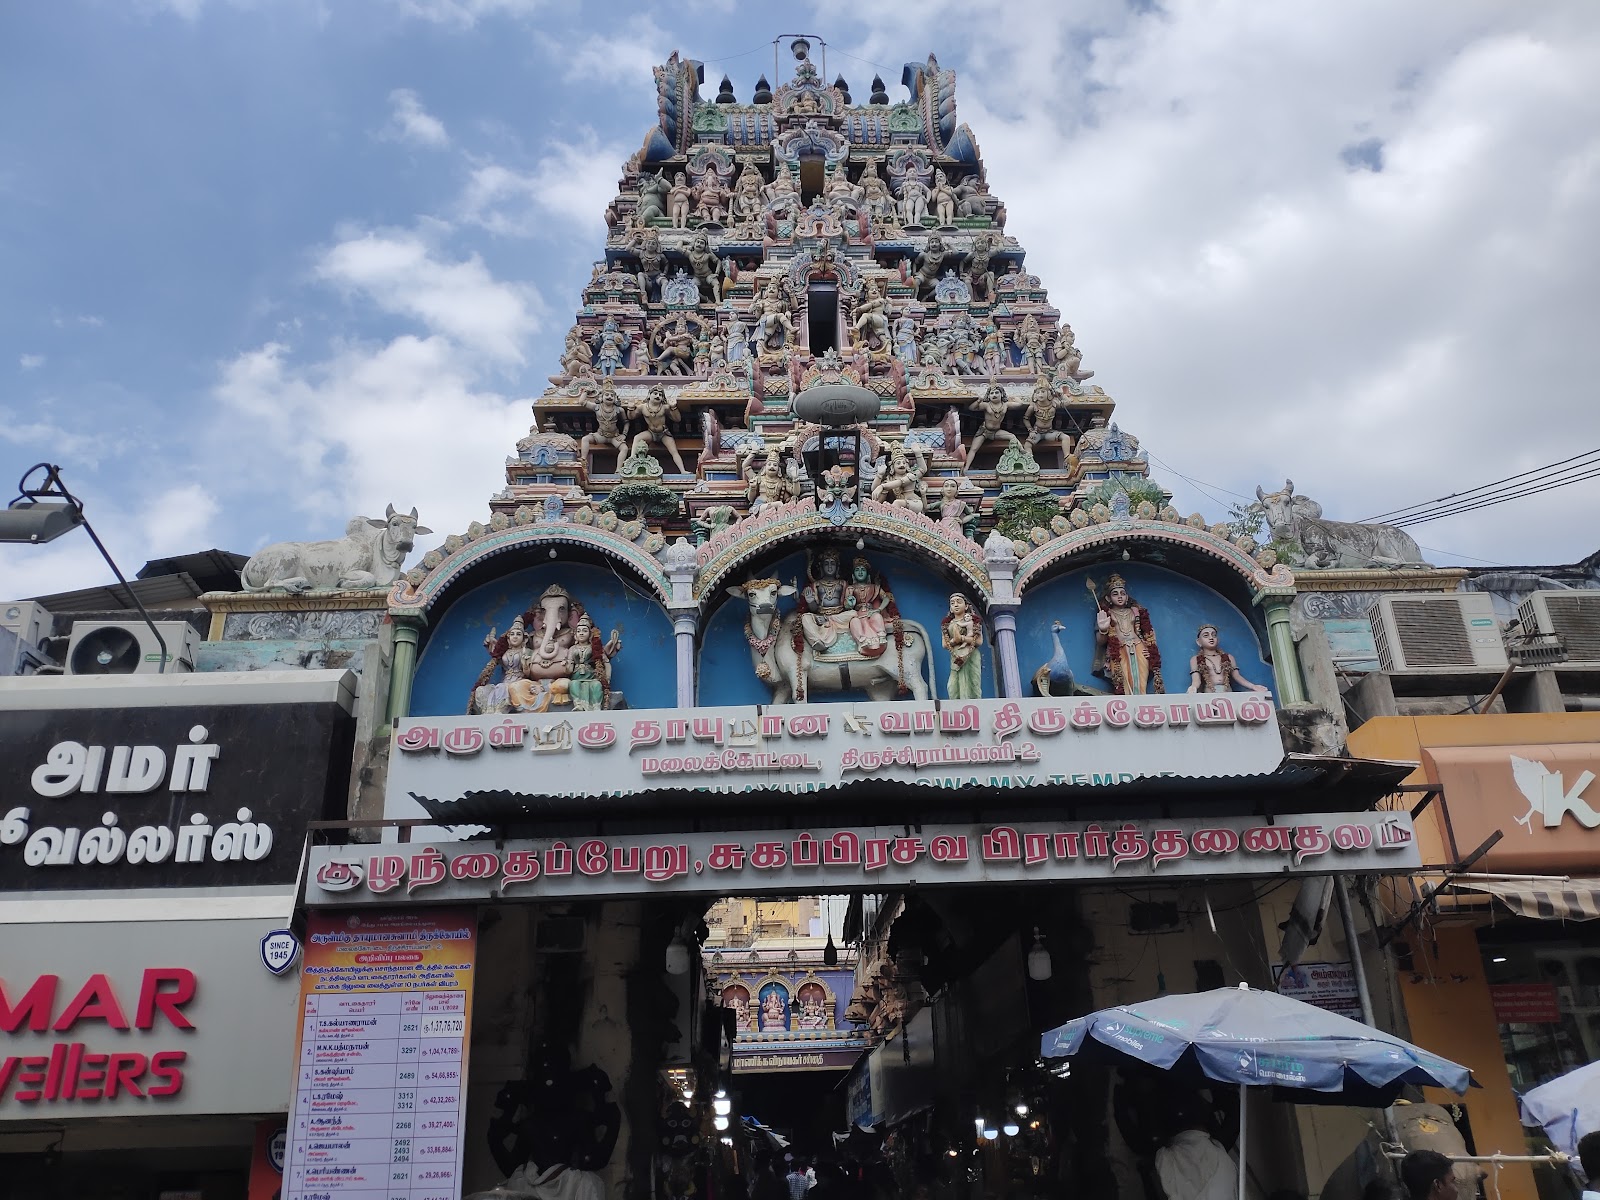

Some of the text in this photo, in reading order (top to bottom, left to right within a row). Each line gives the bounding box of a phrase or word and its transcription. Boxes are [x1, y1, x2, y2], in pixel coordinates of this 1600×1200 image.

[992, 696, 1272, 744] திருக்கோயில்
[31, 724, 220, 797] அமர்
[270, 941, 290, 950] SINCE
[270, 951, 288, 960] 1945
[1116, 1034, 1144, 1051] mobiles
[1124, 1024, 1165, 1044] supreme
